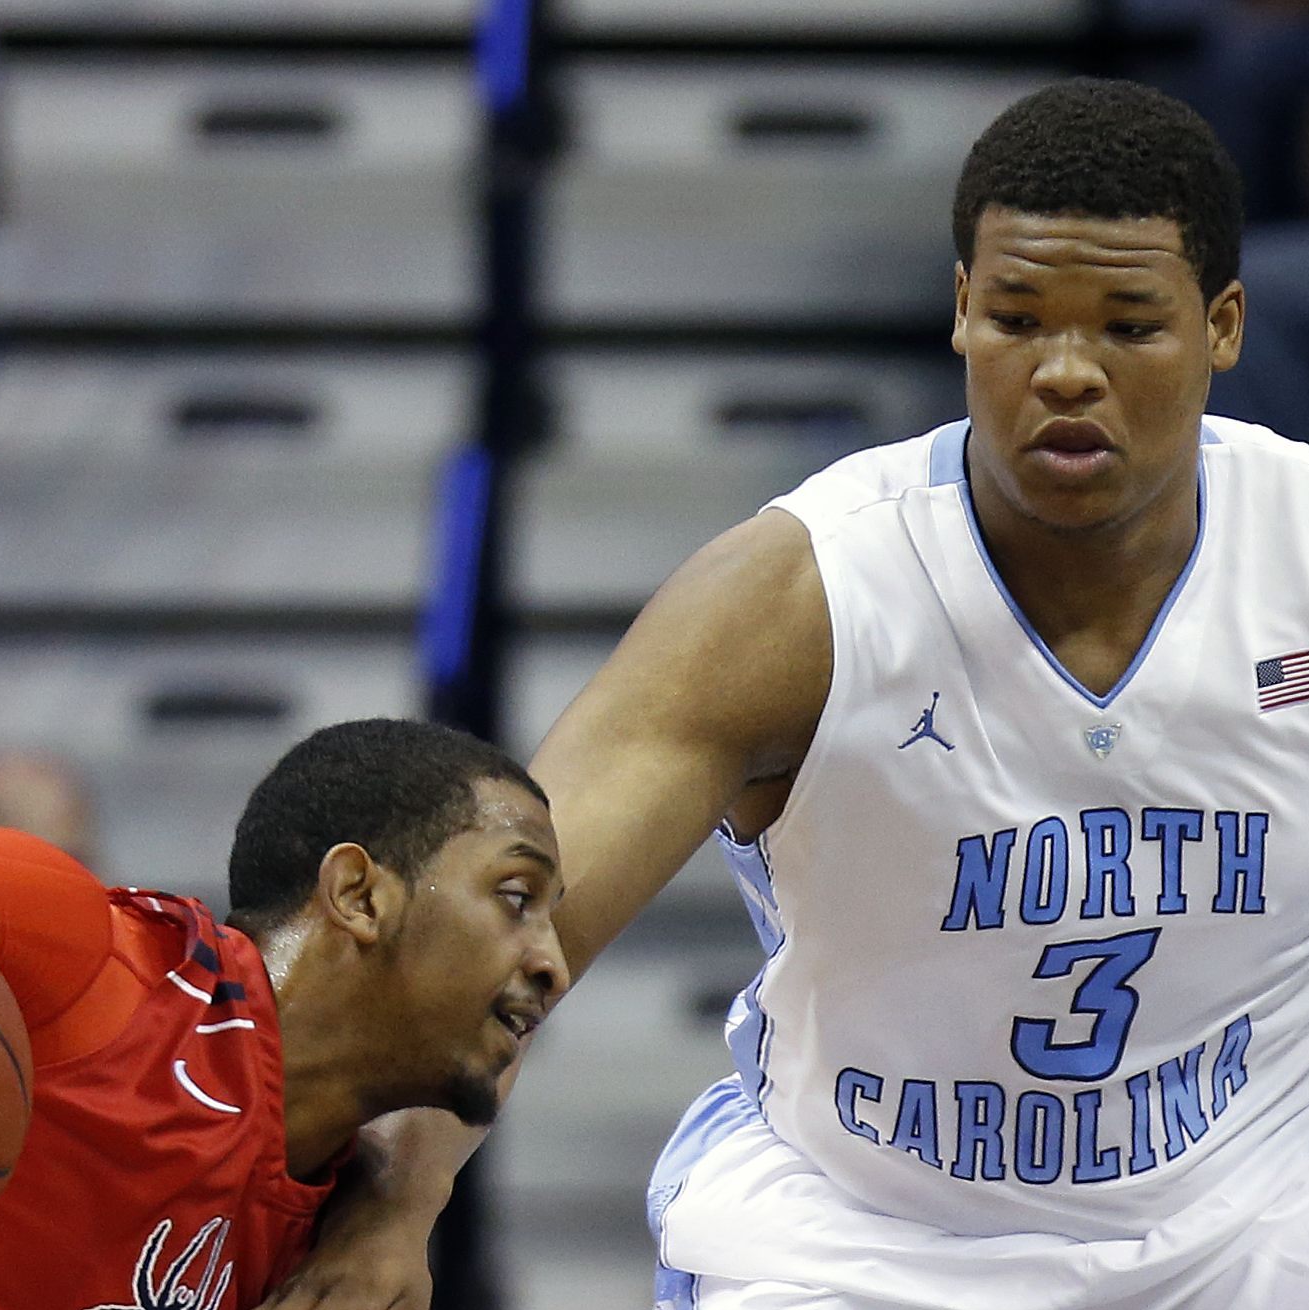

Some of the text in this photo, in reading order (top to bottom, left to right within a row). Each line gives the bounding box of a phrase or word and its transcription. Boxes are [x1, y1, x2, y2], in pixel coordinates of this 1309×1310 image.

[941, 807, 1269, 932] NORTH
[1010, 927, 1162, 1081] 3
[834, 1013, 1252, 1185] CAROLINA
